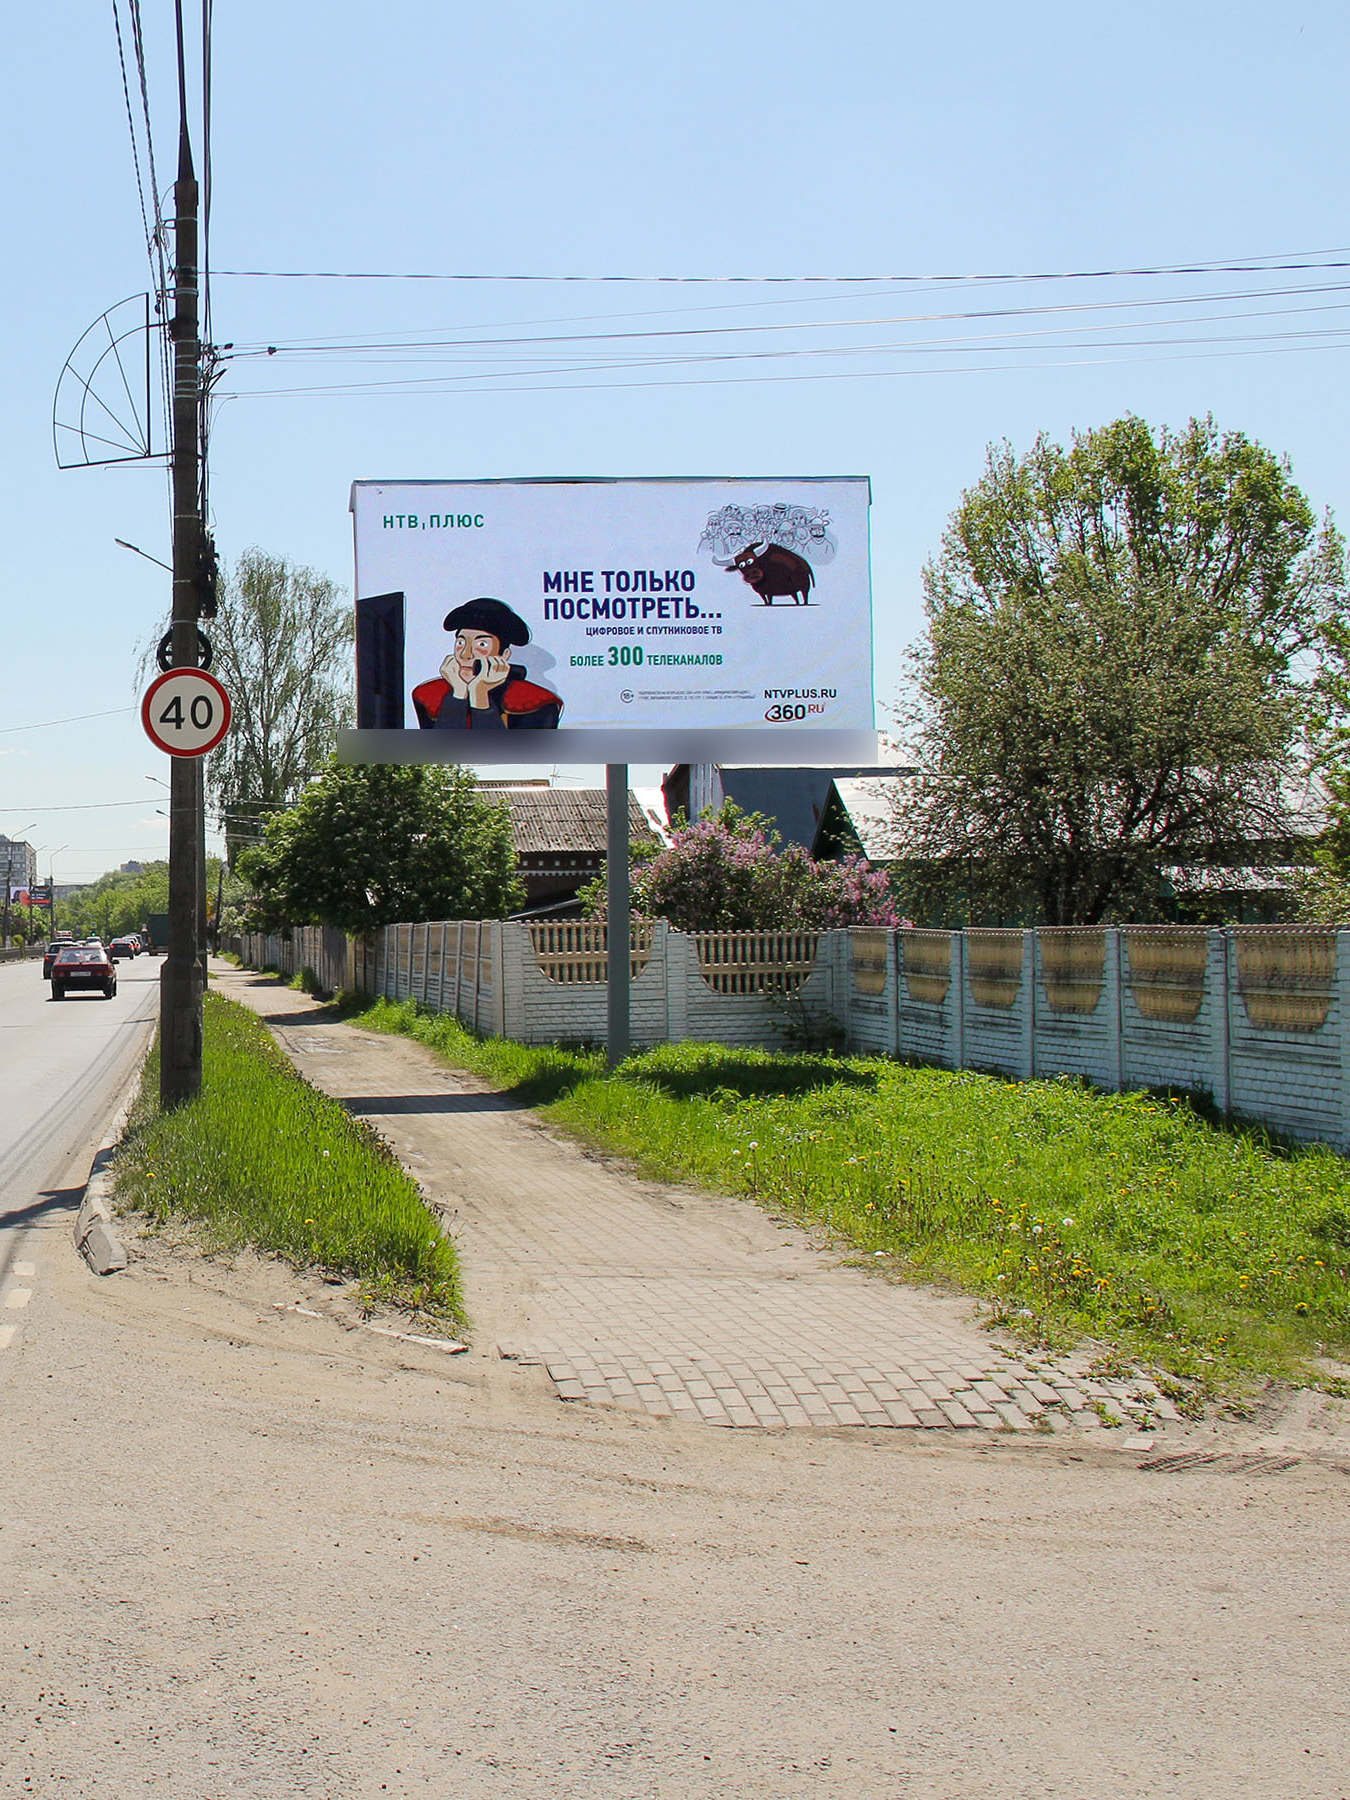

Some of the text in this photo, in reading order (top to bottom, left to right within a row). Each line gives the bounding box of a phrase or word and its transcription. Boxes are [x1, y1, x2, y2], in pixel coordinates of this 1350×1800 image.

[543, 570, 695, 593] МНЕ ТОЛЬКО
[544, 597, 722, 620] ПОСМОТРЕТЬ...
[586, 626, 723, 637] ЦИФРОВОЕ И СПУТНИКОВОЕ ТВ
[570, 646, 723, 667] БОЛЕЕ 300 ТЕЛЕКАНАЛОВ
[764, 689, 837, 699] NTVPLUS.RU
[159, 695, 213, 730] 40
[770, 705, 806, 720] 360
